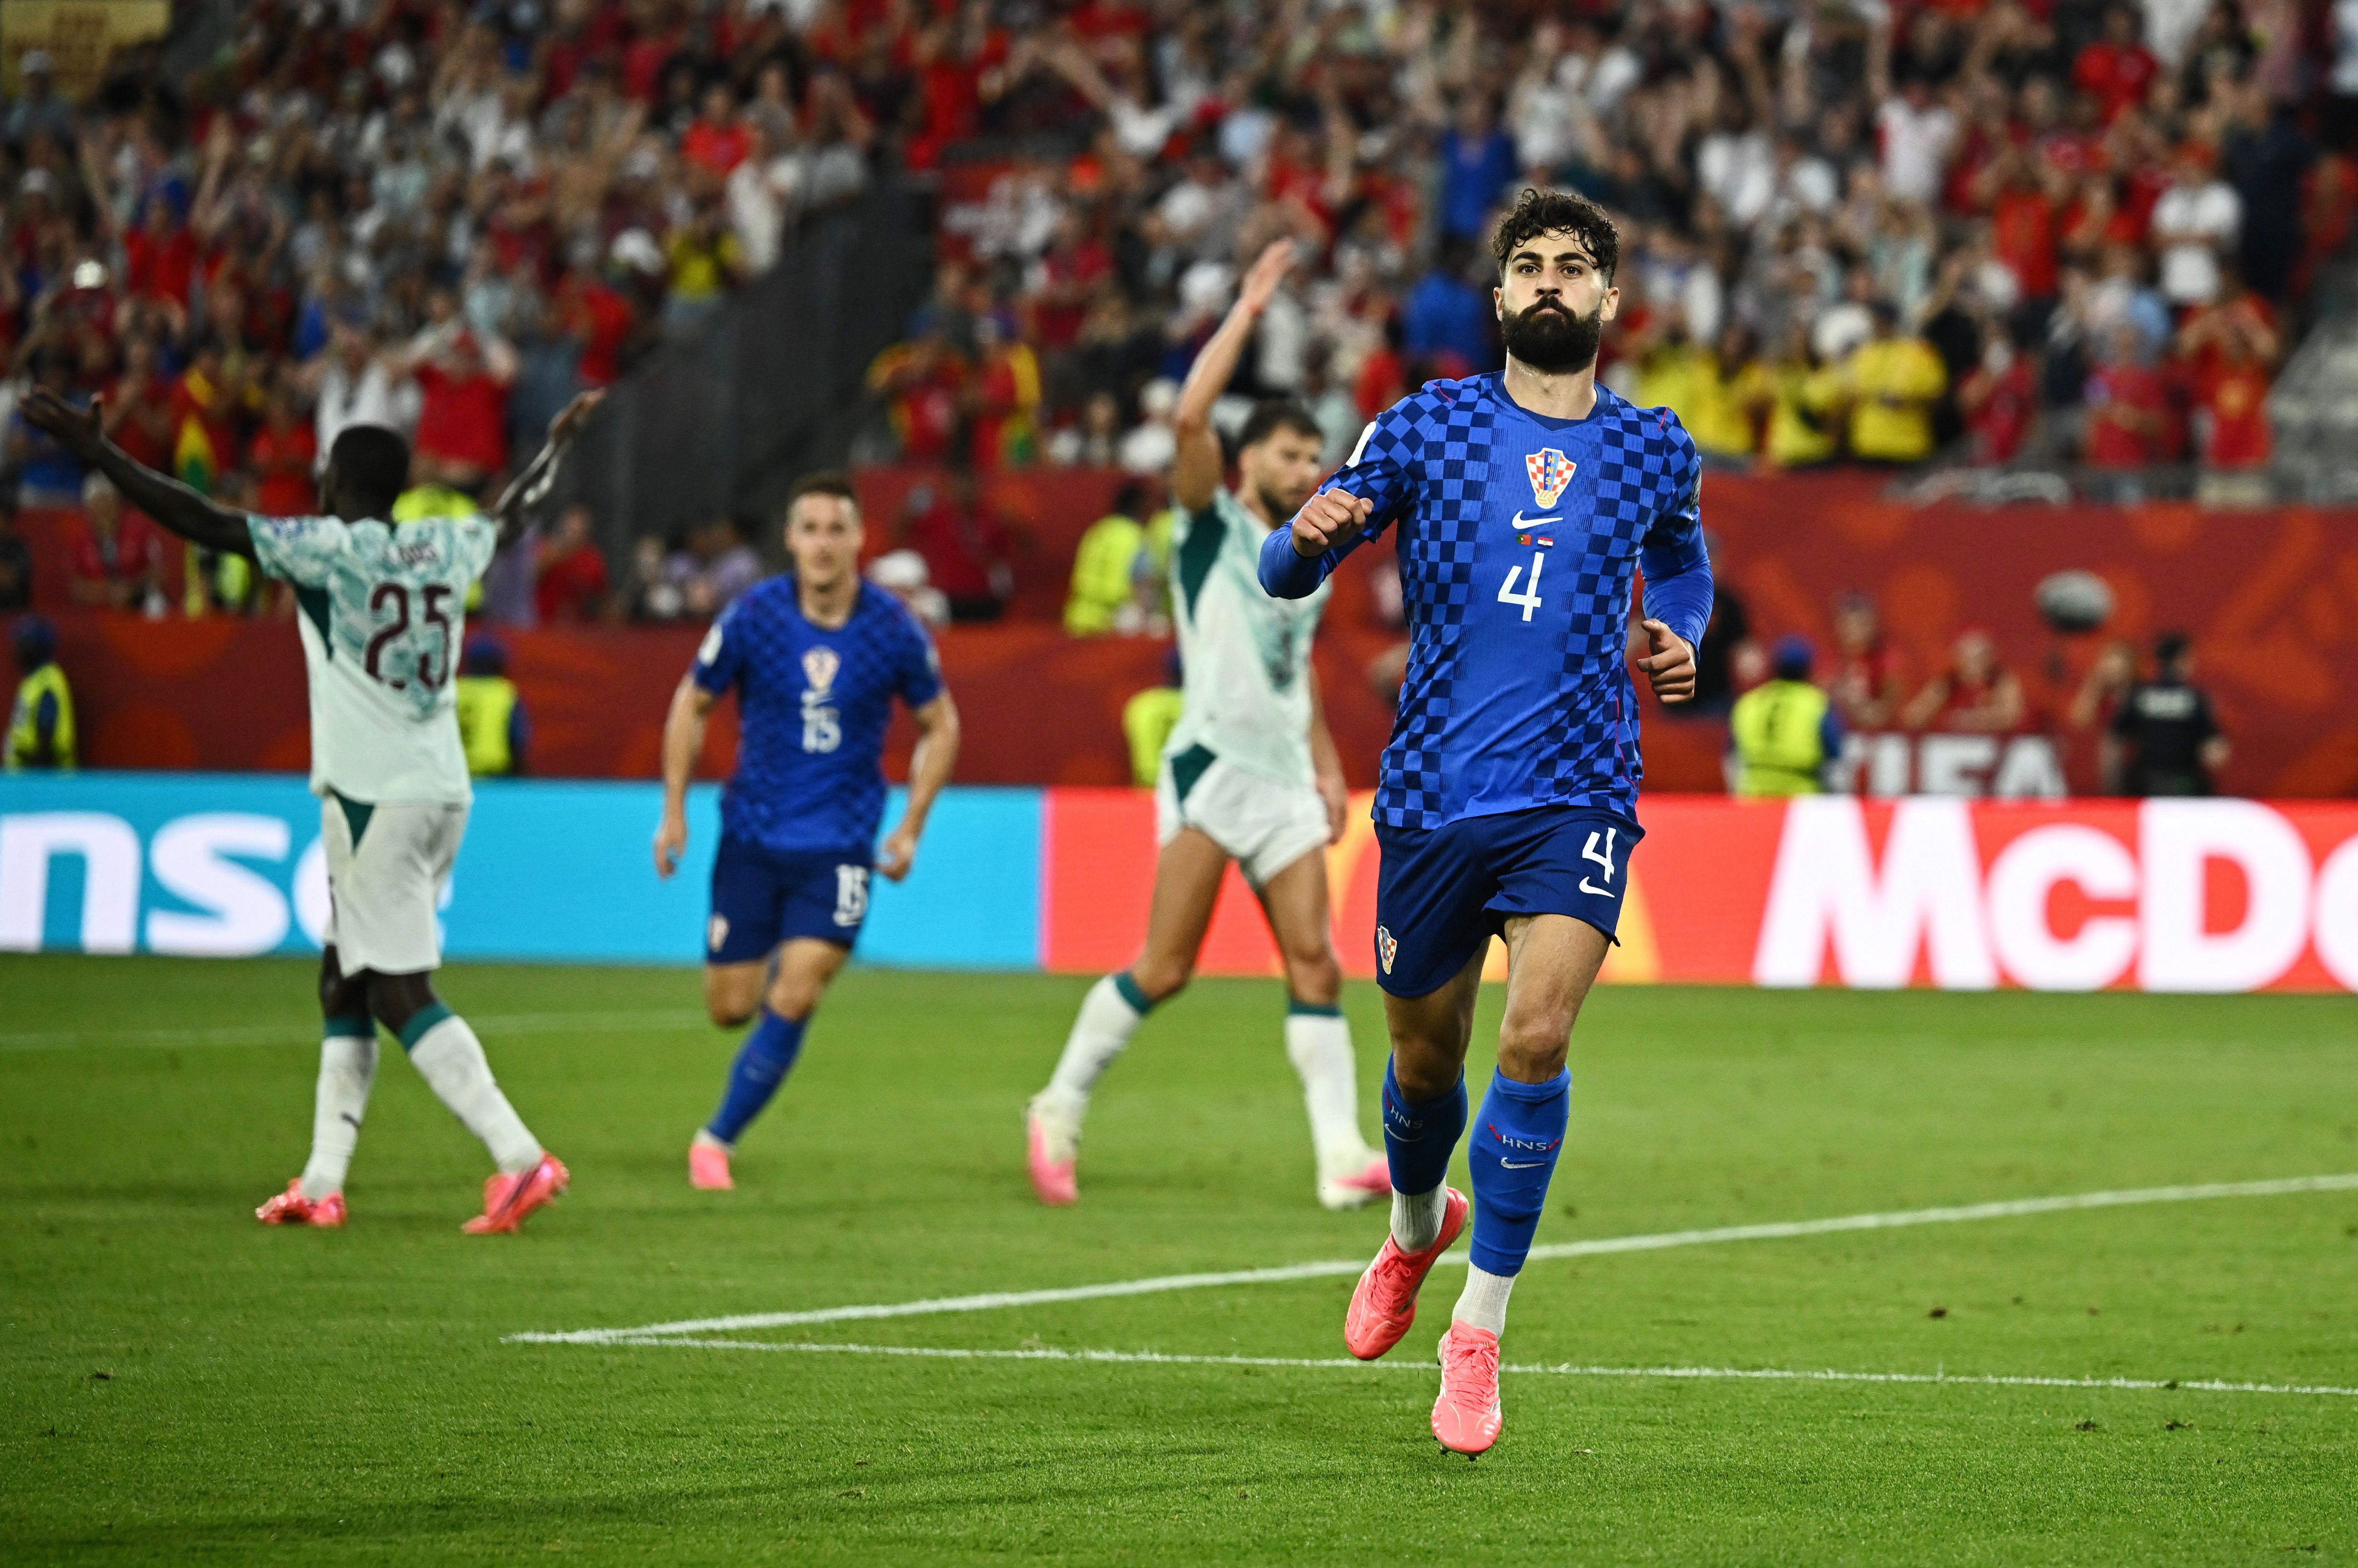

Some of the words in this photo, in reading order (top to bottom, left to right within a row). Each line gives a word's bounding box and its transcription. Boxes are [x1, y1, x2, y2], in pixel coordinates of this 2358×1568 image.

[1545, 456, 1555, 485] HNS
[1497, 552, 1544, 621] 4
[366, 582, 452, 690] 25
[801, 707, 841, 753] 15
[1582, 827, 1616, 884] 4
[835, 864, 868, 919] 15
[1752, 795, 2358, 994] McD
[1391, 1105, 1424, 1129] HNS
[1502, 1134, 1547, 1151] HNS
